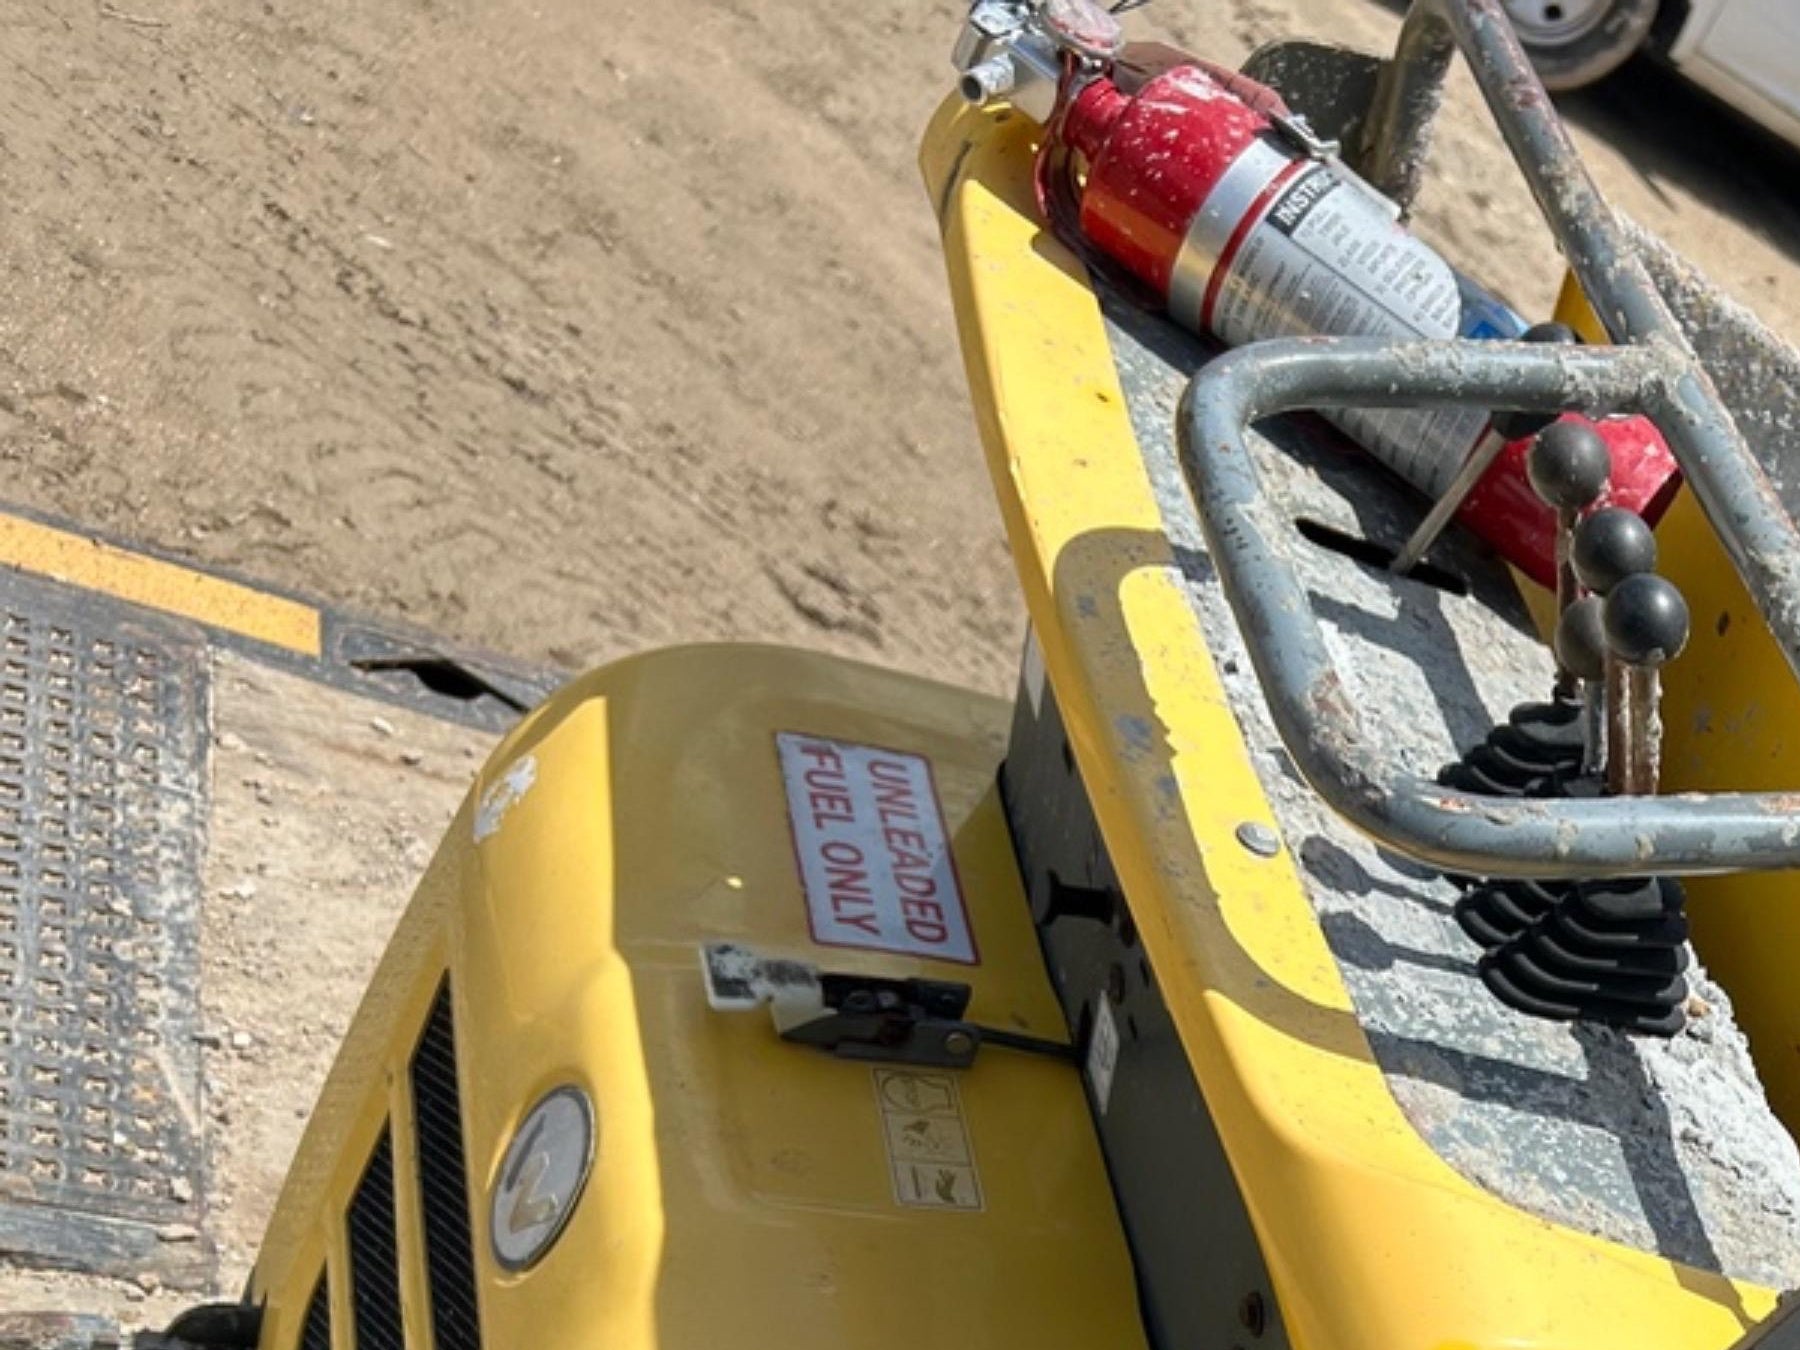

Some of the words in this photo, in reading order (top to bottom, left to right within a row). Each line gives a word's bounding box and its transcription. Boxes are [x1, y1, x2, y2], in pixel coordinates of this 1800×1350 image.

[801, 743, 855, 830] FUEL
[820, 841, 881, 936] ONLY
[866, 760, 948, 943] UNLEADED
